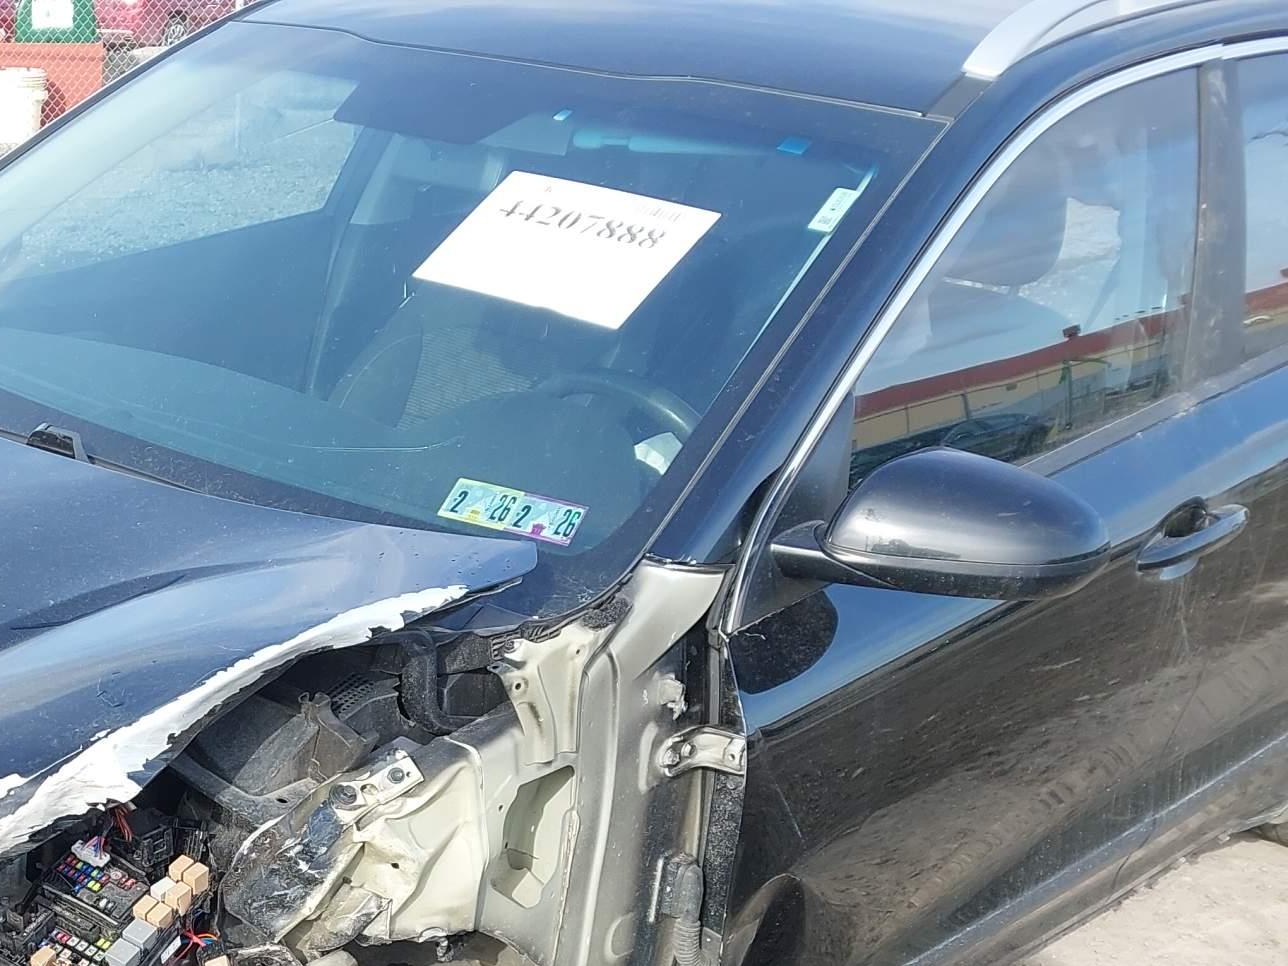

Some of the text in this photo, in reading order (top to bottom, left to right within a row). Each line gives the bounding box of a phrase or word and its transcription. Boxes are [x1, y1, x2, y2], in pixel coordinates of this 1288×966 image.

[500, 200, 665, 248] 44207888
[450, 491, 469, 513] 2
[490, 495, 517, 521] 26
[513, 505, 532, 528] 2
[554, 509, 581, 537] 26
